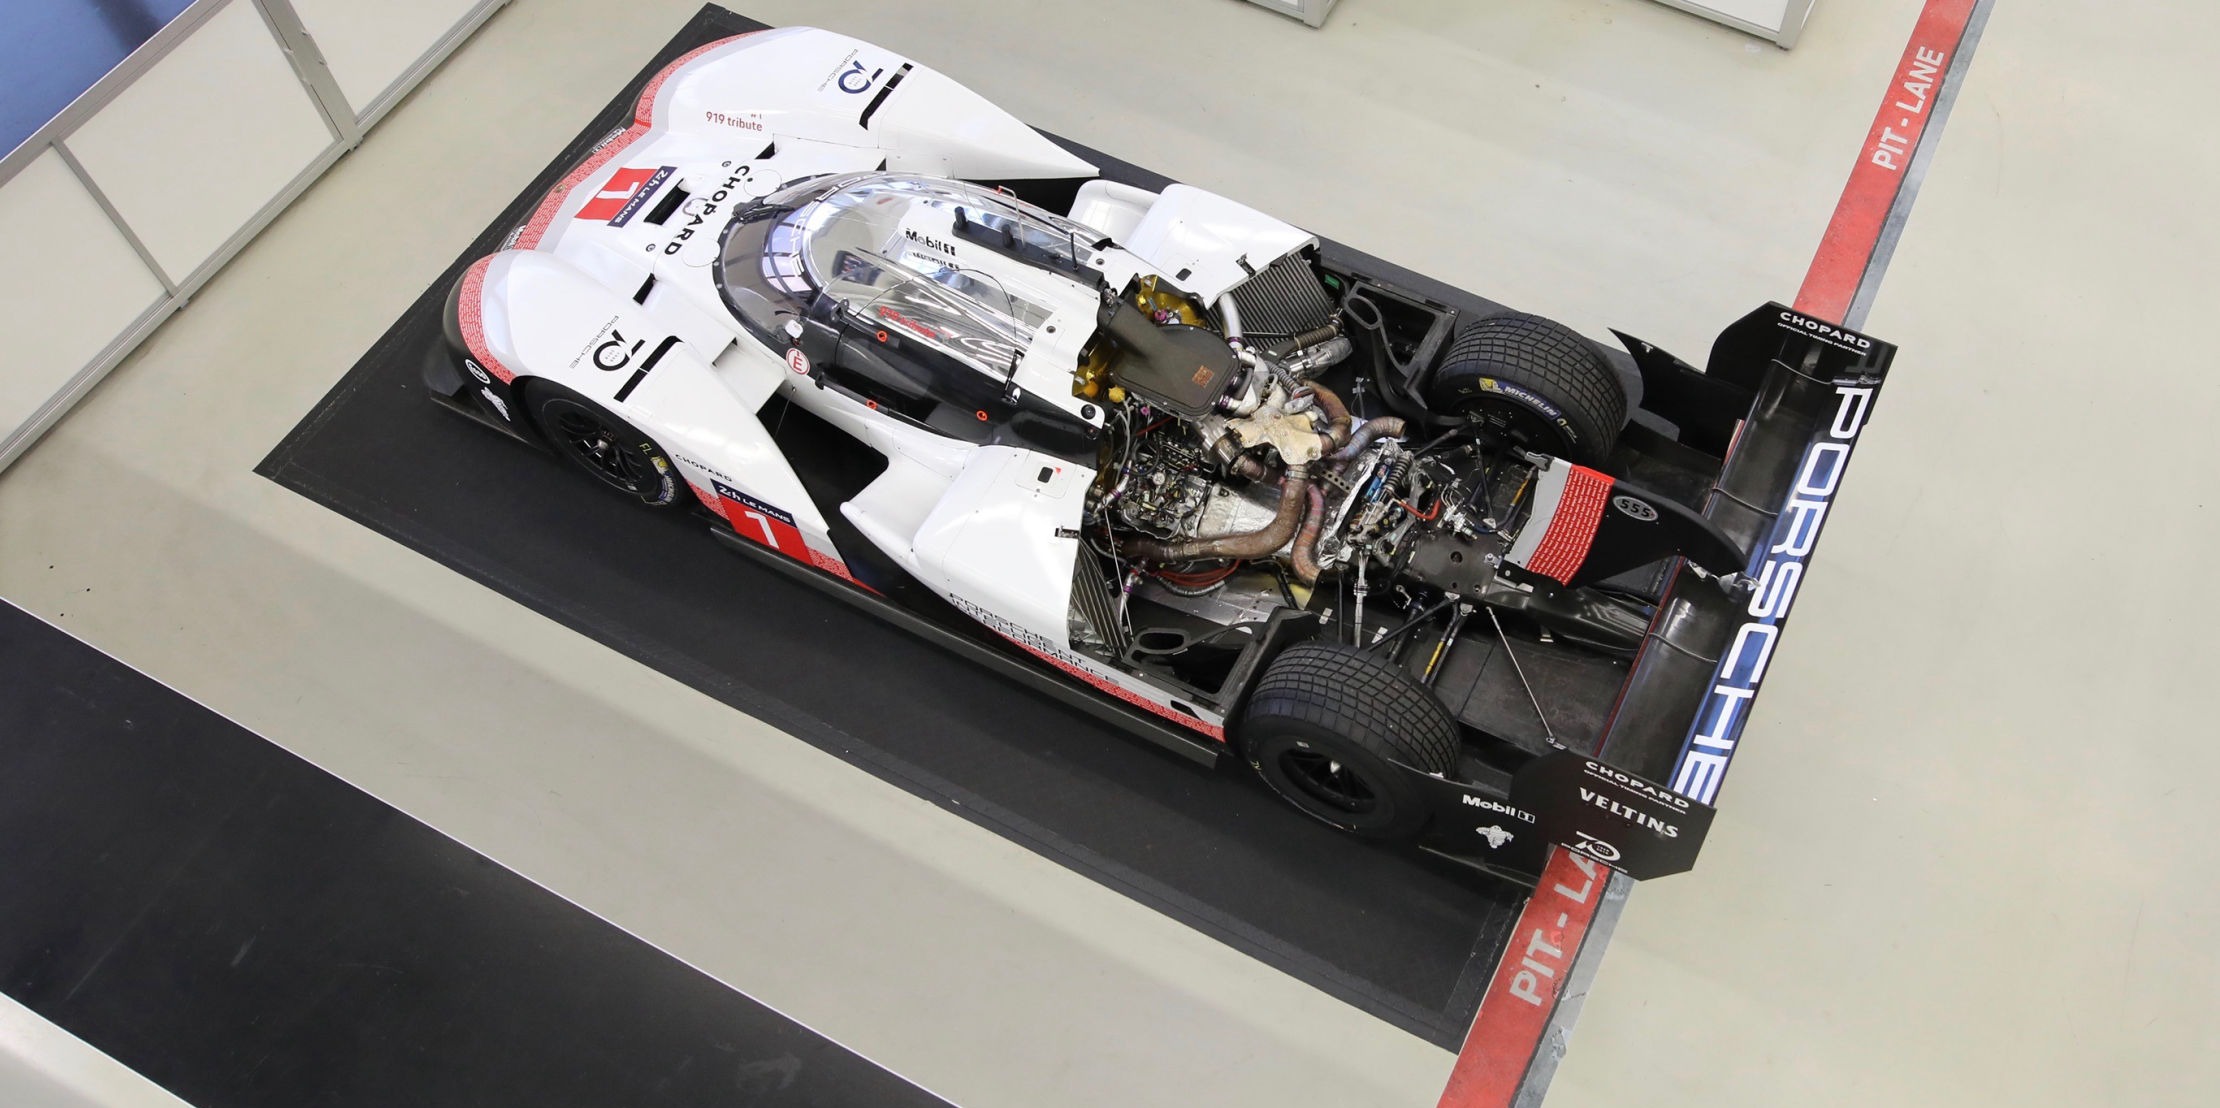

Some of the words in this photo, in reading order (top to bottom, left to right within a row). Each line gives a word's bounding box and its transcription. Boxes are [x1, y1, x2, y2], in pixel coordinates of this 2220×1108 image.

[817, 49, 858, 92] PORSCHE
[706, 111, 726, 125] 919
[727, 117, 763, 132] tribute
[1872, 126, 1908, 170] PIT
[1895, 46, 1944, 114] LANE
[595, 181, 641, 200] 1
[641, 188, 651, 198] LE
[614, 197, 642, 224] MANS
[664, 165, 750, 255] CHOPARD
[569, 315, 619, 369] PORSCHE
[1777, 322, 1808, 337] OFFICIAL
[1807, 333, 1834, 345] TIMING
[1833, 342, 1867, 356] PARTNER
[1780, 312, 1871, 349] CHOPARD
[1504, 386, 1558, 416] MICHELIN
[640, 442, 653, 455] FL
[675, 454, 732, 482] CHOPARD
[743, 499, 757, 508] LE
[758, 505, 791, 523] MANS
[1619, 499, 1651, 518] 555
[744, 510, 780, 550] 1
[1673, 387, 1872, 806] PORSCHE
[1584, 769, 1619, 787] OFFICIAL
[1618, 784, 1647, 799] TIMING
[1648, 796, 1686, 815] PARTNER
[1585, 761, 1689, 808] CHOPARD
[1462, 794, 1516, 816] Mobil
[1579, 787, 1679, 838] VELTINS
[1561, 842, 1628, 874] PORSCHE
[1509, 928, 1562, 1007] PIT
[1554, 852, 1597, 904] LA
